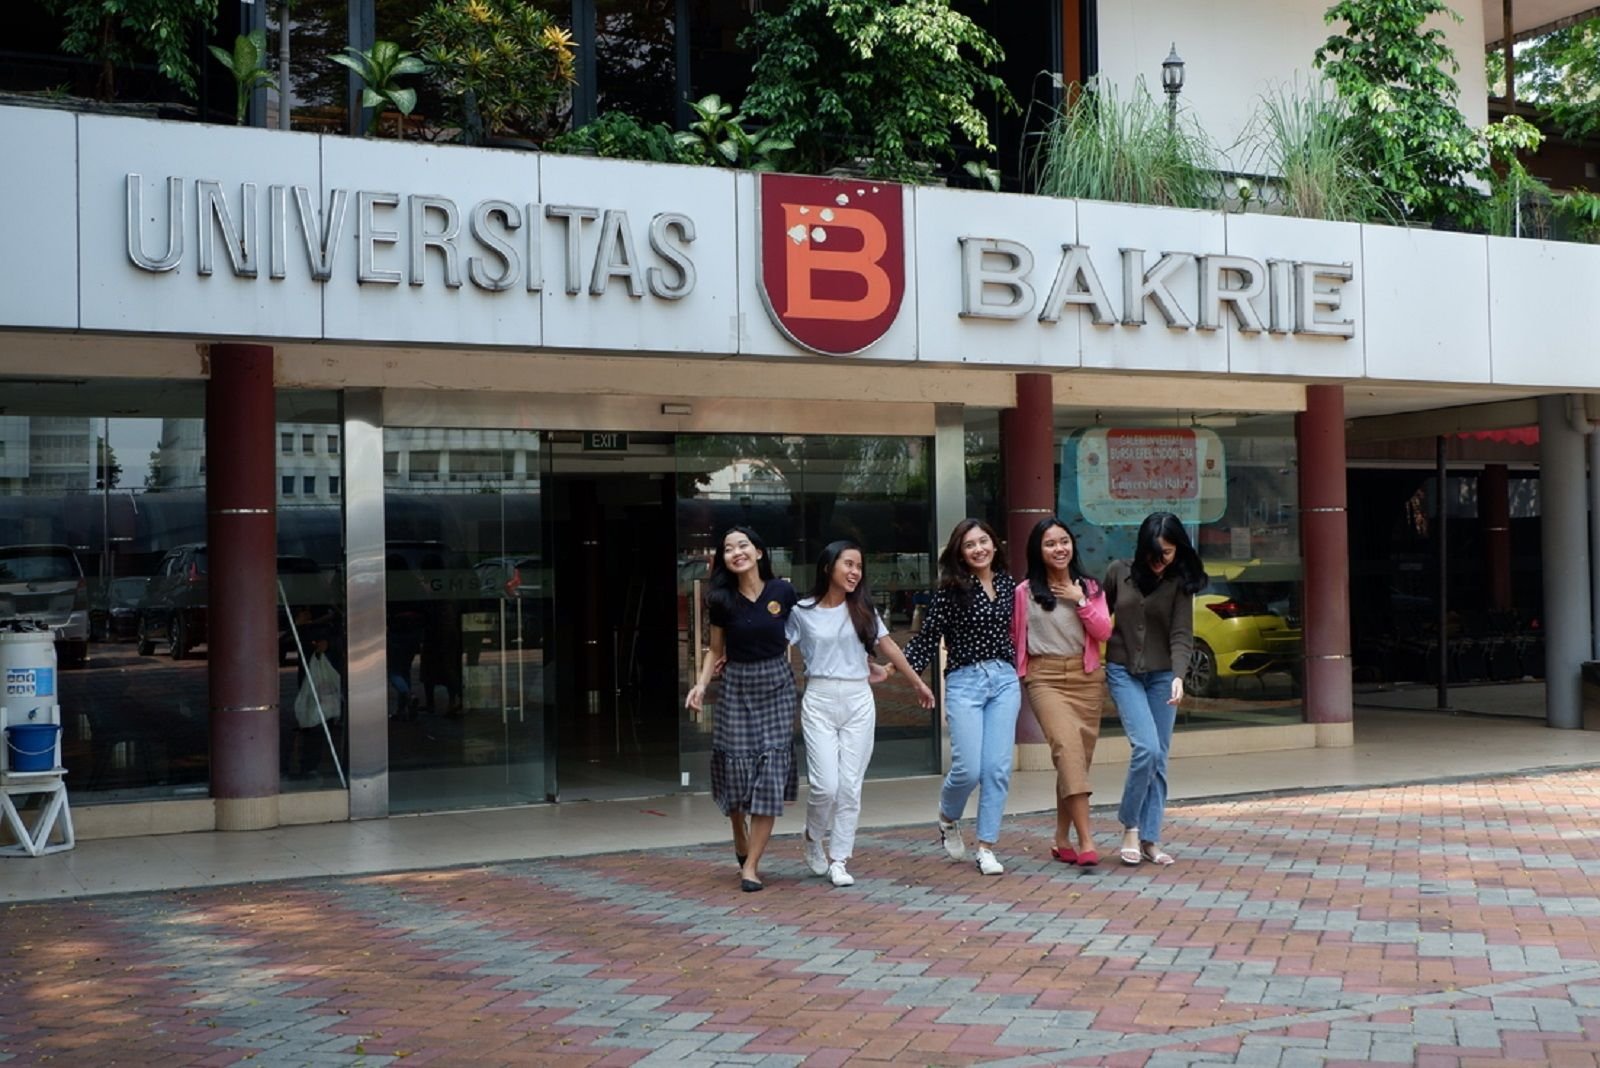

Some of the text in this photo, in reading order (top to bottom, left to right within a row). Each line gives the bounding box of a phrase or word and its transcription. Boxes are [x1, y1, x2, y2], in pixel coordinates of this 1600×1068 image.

[125, 172, 1355, 340] UNIVERSITAS BAKRIE
[780, 202, 891, 322] B
[591, 433, 618, 448] EXIT
